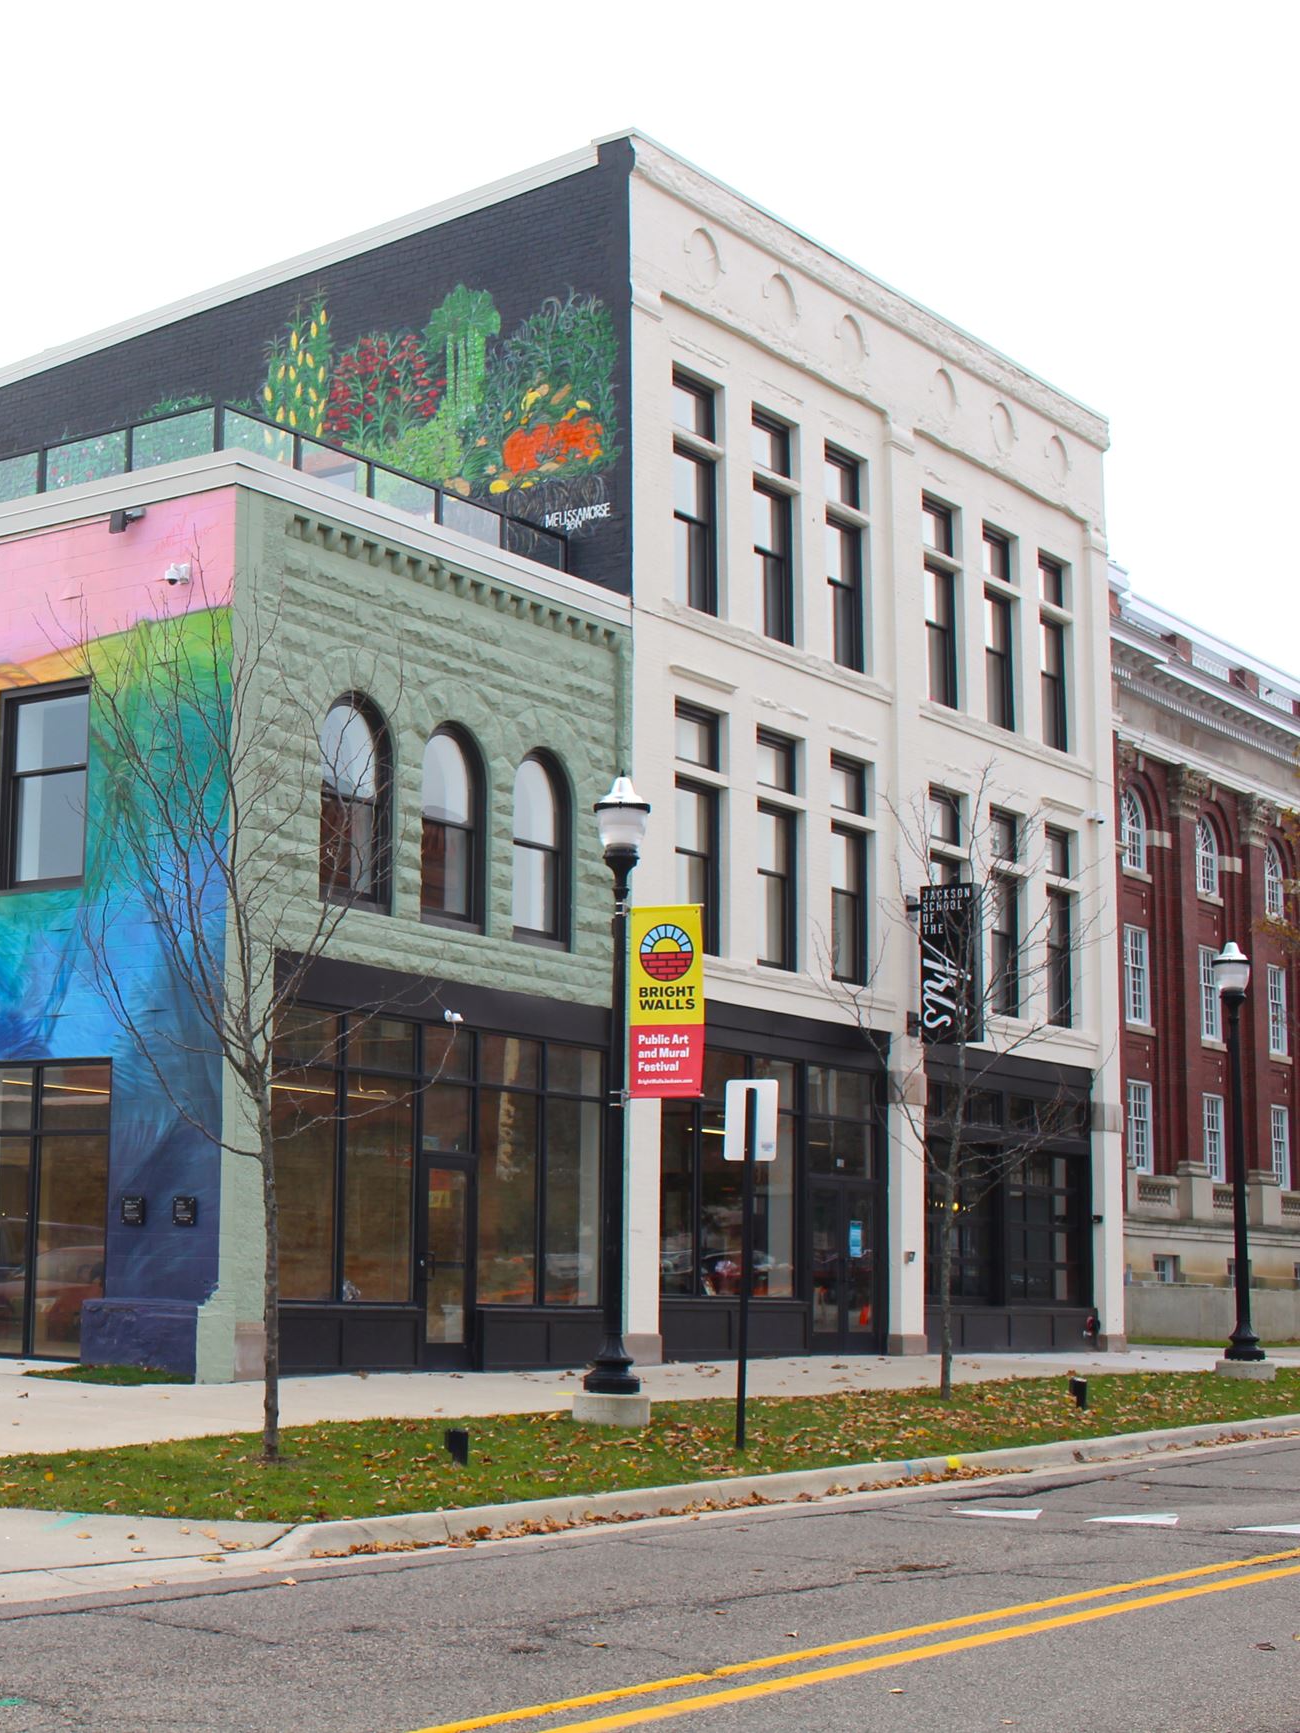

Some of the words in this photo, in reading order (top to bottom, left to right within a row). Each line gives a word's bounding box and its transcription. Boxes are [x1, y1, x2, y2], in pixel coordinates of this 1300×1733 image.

[922, 887, 971, 900] JACKSON
[922, 899, 963, 912] SCHOOL
[922, 911, 935, 923] OF
[923, 923, 944, 935] THE
[638, 986, 695, 998] BRIGHT
[639, 998, 695, 1011] WALLS
[638, 1034, 670, 1045] Public
[671, 1033, 689, 1045] Art
[638, 1047, 657, 1058] and
[659, 1047, 689, 1058] Mural
[638, 1061, 679, 1072] Festival
